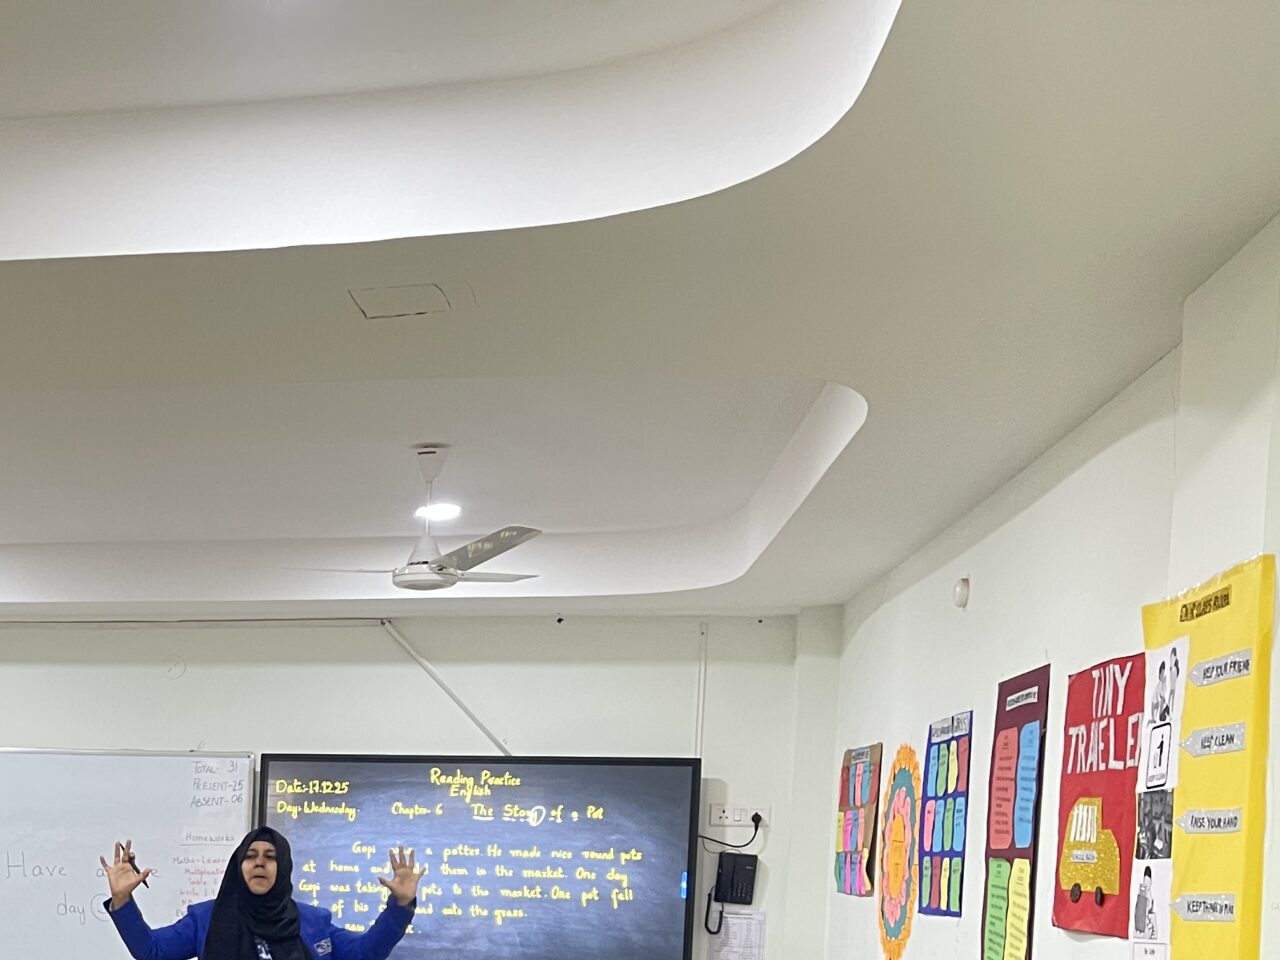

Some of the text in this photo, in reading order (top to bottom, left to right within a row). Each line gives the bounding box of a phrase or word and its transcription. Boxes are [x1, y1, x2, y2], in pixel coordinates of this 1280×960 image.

[1091, 661, 1132, 719] TINY
[1215, 734, 1235, 747] CLEAN
[227, 760, 238, 773] 31
[430, 768, 521, 787] Reading Practice
[450, 784, 491, 803] English
[435, 803, 444, 815] 6
[470, 803, 494, 817] The
[504, 804, 538, 823] Story
[551, 805, 564, 822] of
[587, 805, 604, 820] Pot
[1207, 816, 1222, 829] YOUR
[1223, 816, 1239, 828] HAND
[352, 841, 376, 859] Gopi
[487, 844, 502, 857] He
[510, 846, 541, 858] made
[551, 849, 572, 859] nice
[582, 848, 614, 861] round
[620, 849, 642, 865] pots
[6, 851, 67, 879] Have
[303, 860, 316, 873] at
[330, 860, 360, 873] home
[370, 862, 390, 875] and
[440, 863, 469, 876] them
[476, 867, 487, 876] in
[495, 864, 514, 877] the
[522, 866, 568, 879] market.
[575, 867, 597, 880] One
[606, 868, 629, 888] day
[298, 879, 320, 897] Gopi
[330, 884, 351, 893] was
[355, 880, 389, 901] taking
[421, 884, 443, 901] pots
[452, 883, 463, 895] to
[471, 885, 490, 897] the
[551, 886, 571, 900] One
[581, 887, 600, 908] pot
[611, 888, 634, 910] fell
[57, 892, 86, 925] day
[331, 900, 345, 919] of
[354, 900, 369, 913] his
[470, 904, 489, 917] the
[494, 909, 528, 926] grass.
[1187, 900, 1201, 914] KEEP
[344, 923, 365, 932] saw
